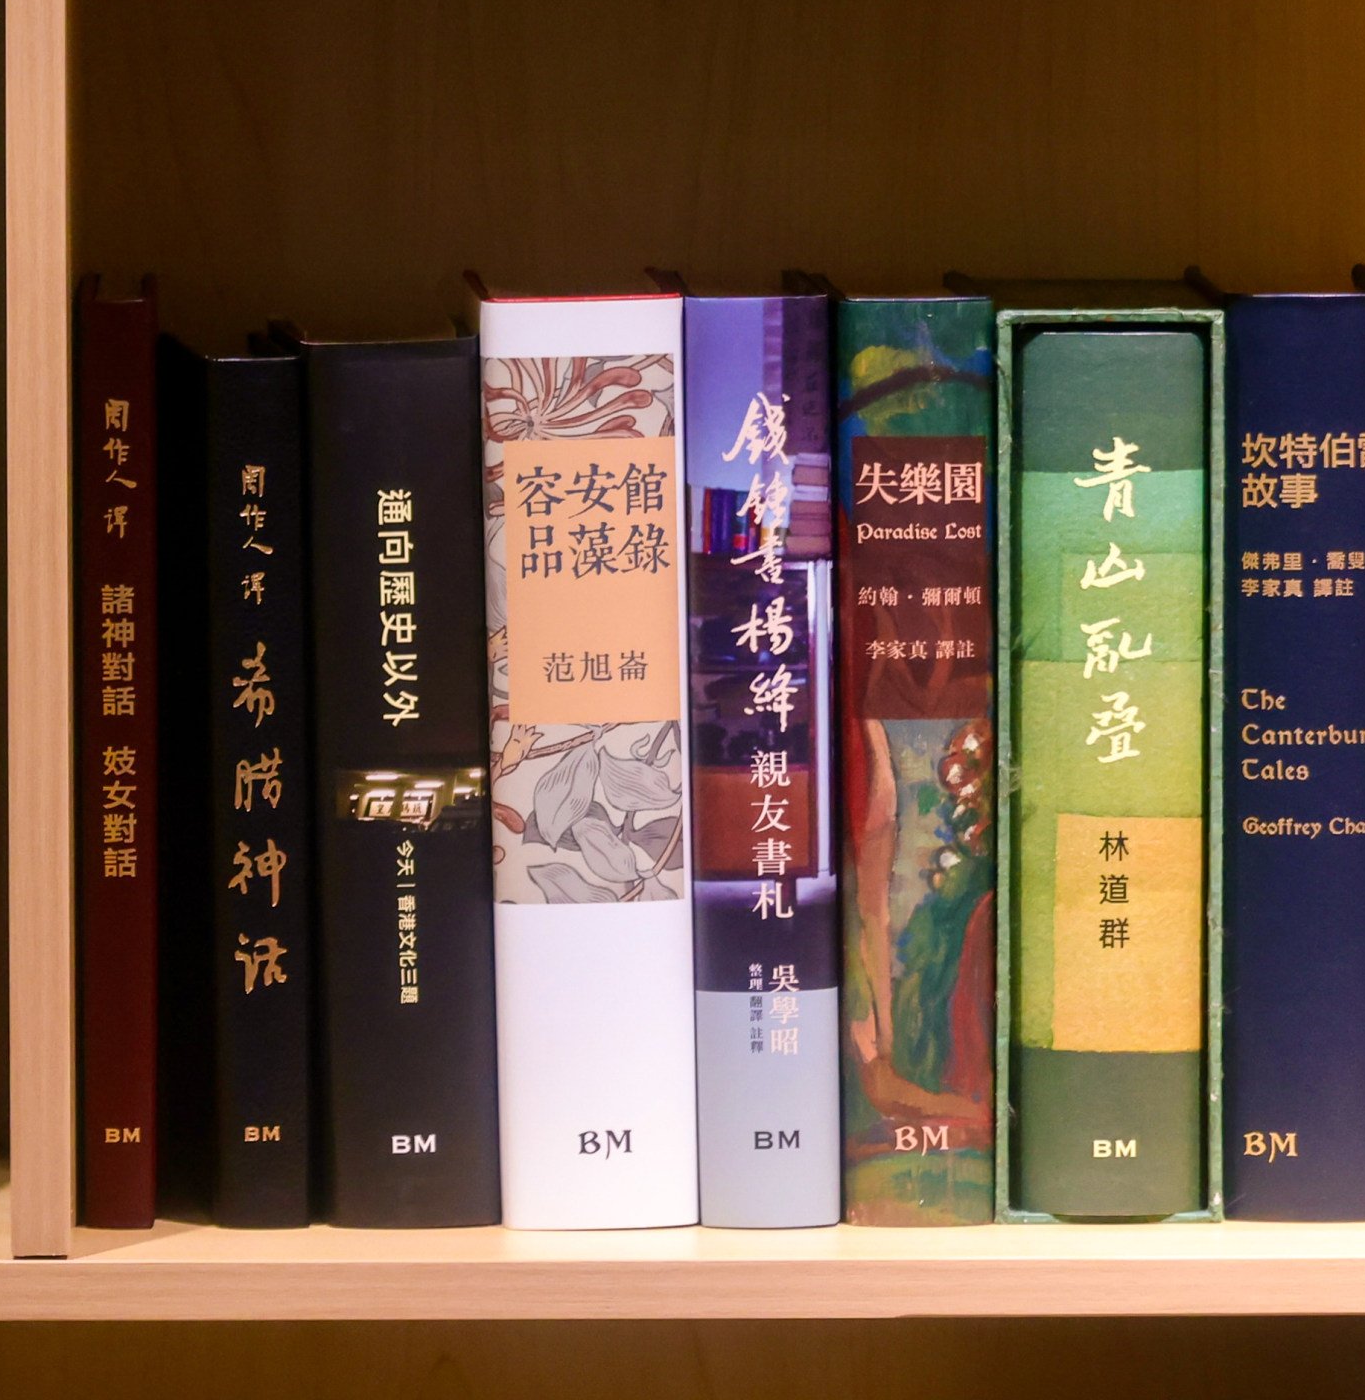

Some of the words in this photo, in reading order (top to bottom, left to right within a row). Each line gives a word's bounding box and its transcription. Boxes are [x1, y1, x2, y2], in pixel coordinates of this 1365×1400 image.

[515, 463, 668, 519] 容安館
[855, 462, 982, 505] 失樂園
[1241, 473, 1318, 509] 故事
[857, 522, 938, 543] Paradise
[944, 523, 982, 540] Lost
[521, 523, 671, 580] 品藻錄
[1241, 578, 1303, 597] 李家真
[377, 489, 419, 726] 通向歷史以外
[102, 584, 135, 716] 諸神對話
[865, 640, 927, 659] 李家真
[1241, 689, 1285, 710] The
[1241, 760, 1309, 780] Tales
[102, 746, 137, 878] 妓女對話
[749, 750, 794, 919] 親友書札
[1243, 816, 1321, 838] Geoffrey
[1098, 831, 1130, 949] 林道群
[105, 1128, 141, 1143] BM
[244, 1127, 281, 1142] BM
[392, 1135, 436, 1154] BM
[578, 1130, 633, 1159] BM
[753, 1131, 801, 1150] BM
[894, 1126, 949, 1156] BM
[1093, 1140, 1137, 1158] BM
[1243, 1132, 1297, 1162] BM
